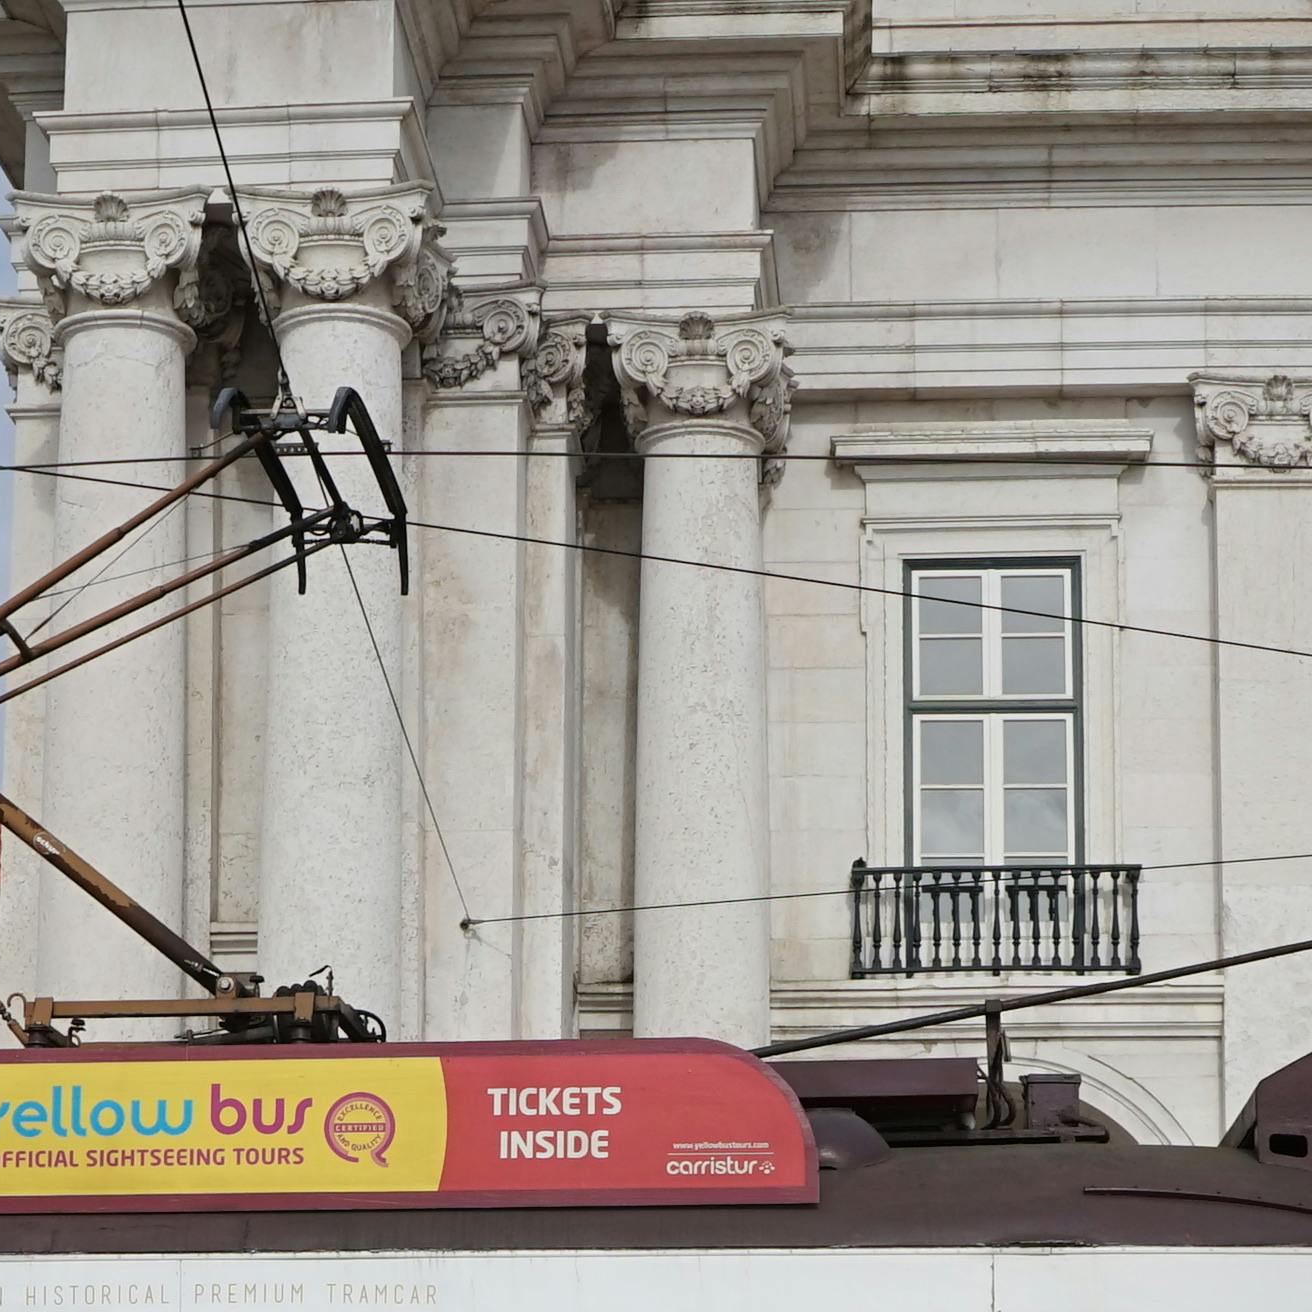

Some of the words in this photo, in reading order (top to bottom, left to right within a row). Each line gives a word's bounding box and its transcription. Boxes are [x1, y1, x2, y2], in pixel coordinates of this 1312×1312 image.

[210, 1083, 313, 1135] bus
[488, 1086, 622, 1117] TICKETS
[335, 1124, 385, 1132] CERTIFIED
[499, 1128, 609, 1160] INSIDE
[86, 1148, 225, 1167] SIGHTSEEING
[233, 1147, 304, 1166] TOURS
[666, 1155, 758, 1175] carristur
[25, 1283, 170, 1307] HISTORICAL
[194, 1283, 304, 1305] PREMIUM
[326, 1283, 438, 1306] TRAMCAR
